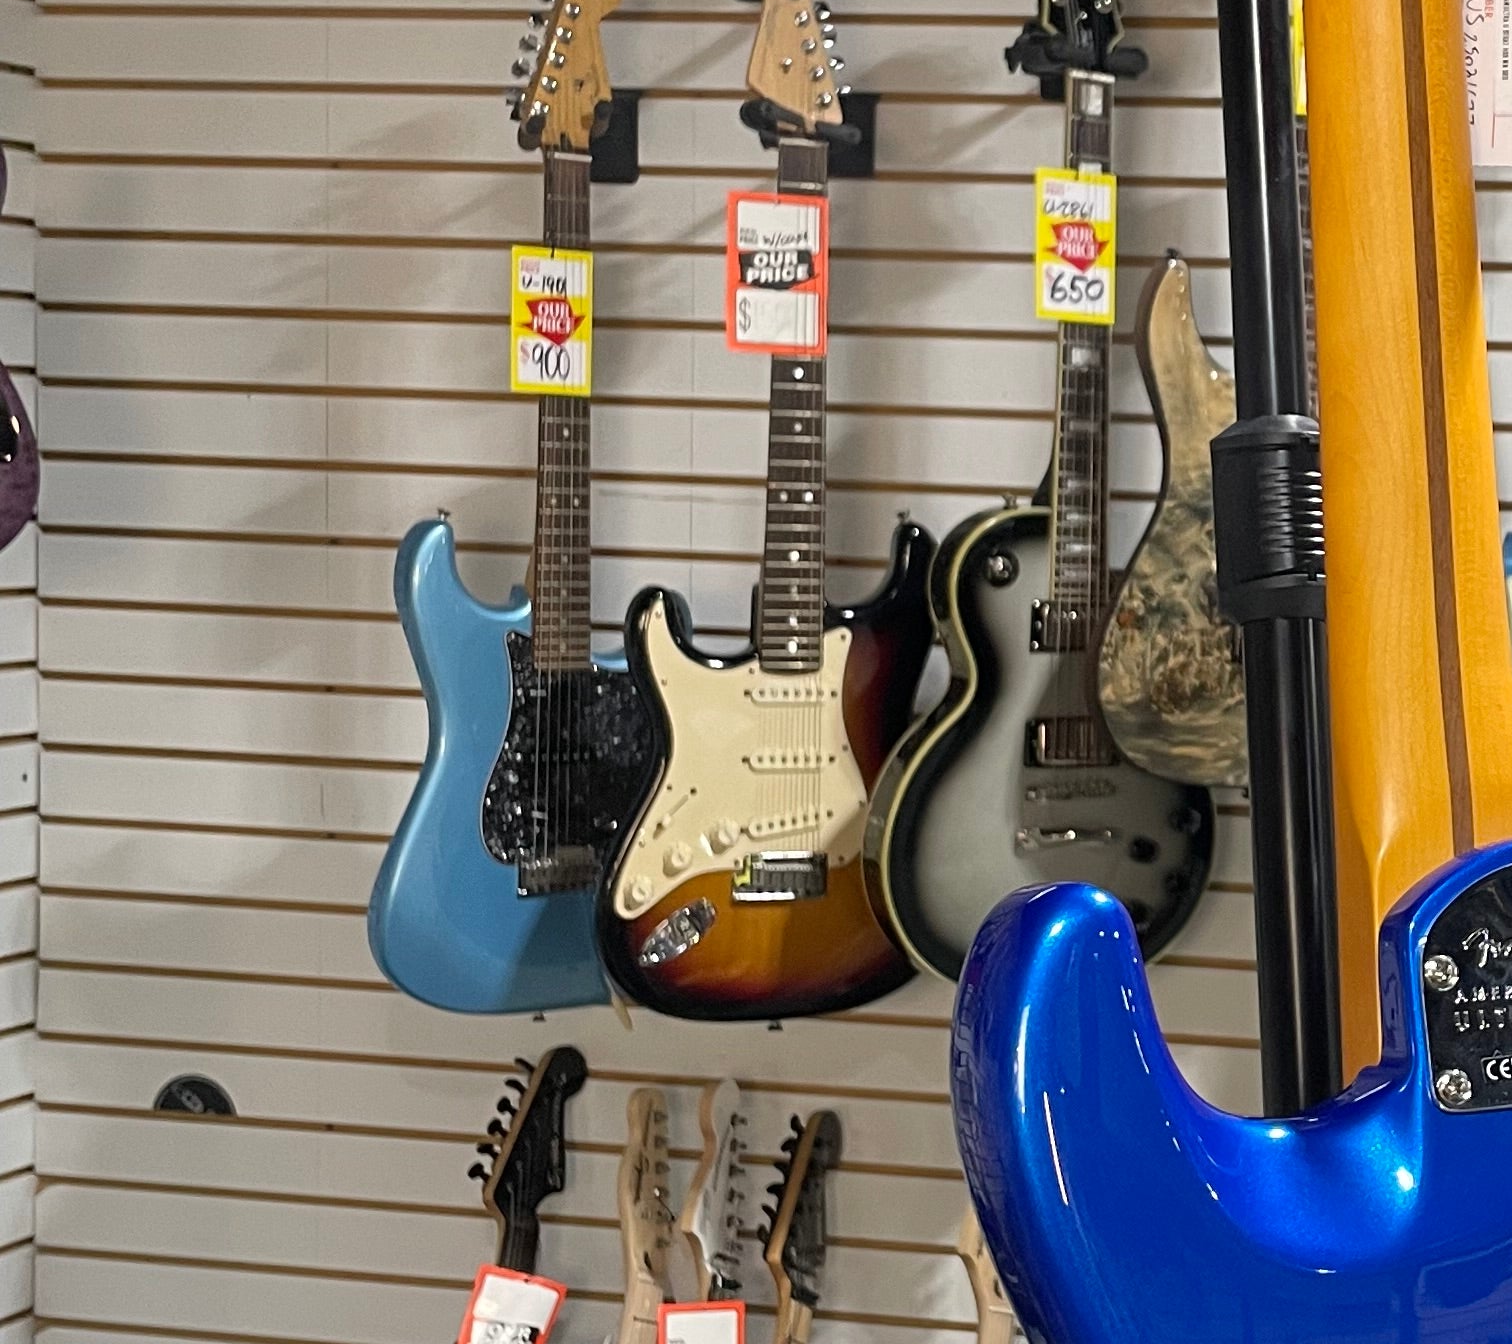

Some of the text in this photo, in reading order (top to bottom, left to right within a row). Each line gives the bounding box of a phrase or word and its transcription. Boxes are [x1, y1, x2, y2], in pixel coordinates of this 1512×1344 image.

[1061, 225, 1095, 243] OUR
[753, 251, 798, 267] OUR
[1057, 240, 1099, 260] PRICE
[746, 264, 809, 284] PRICE
[538, 301, 570, 318] OUR
[532, 316, 575, 334] PRICE
